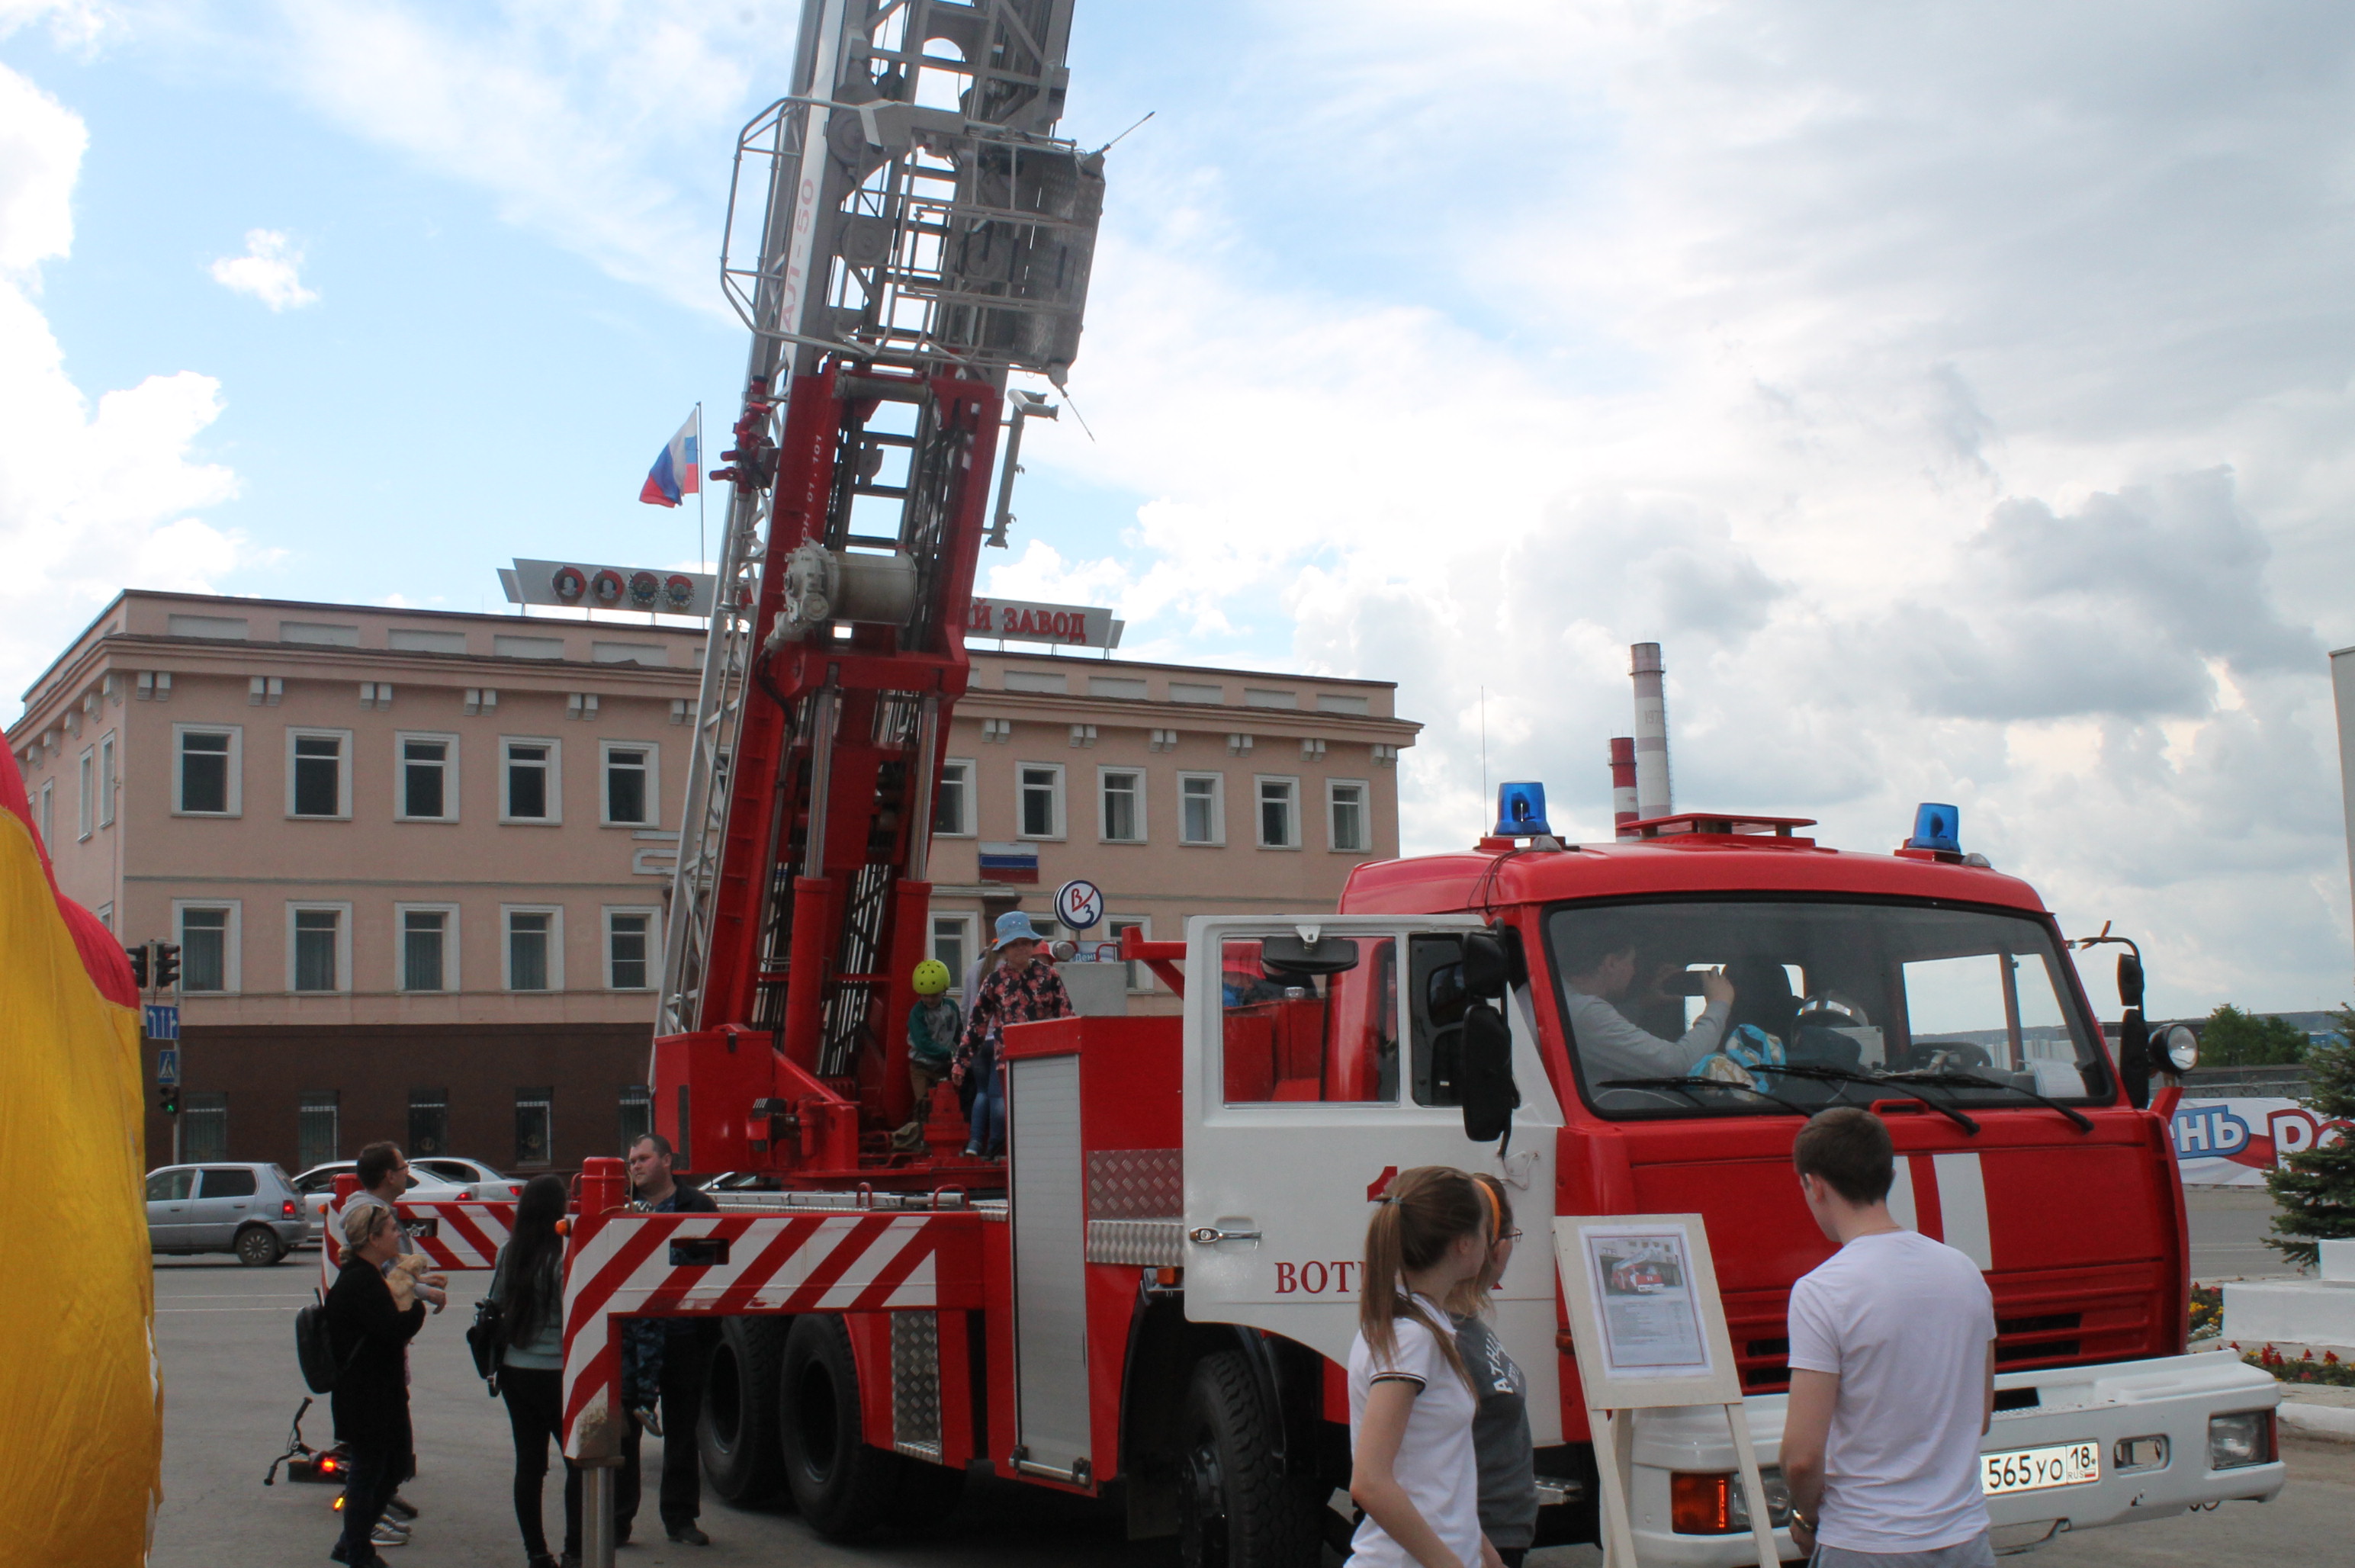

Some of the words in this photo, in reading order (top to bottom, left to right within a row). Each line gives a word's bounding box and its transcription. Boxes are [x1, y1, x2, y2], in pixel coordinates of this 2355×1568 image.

[1002, 607, 1086, 643] ЗАВОД
[1274, 1260, 1367, 1293] ВОТ
[1987, 1454, 2063, 1489] 565УО
[2070, 1446, 2090, 1469] 18
[2067, 1470, 2084, 1480] RUS
